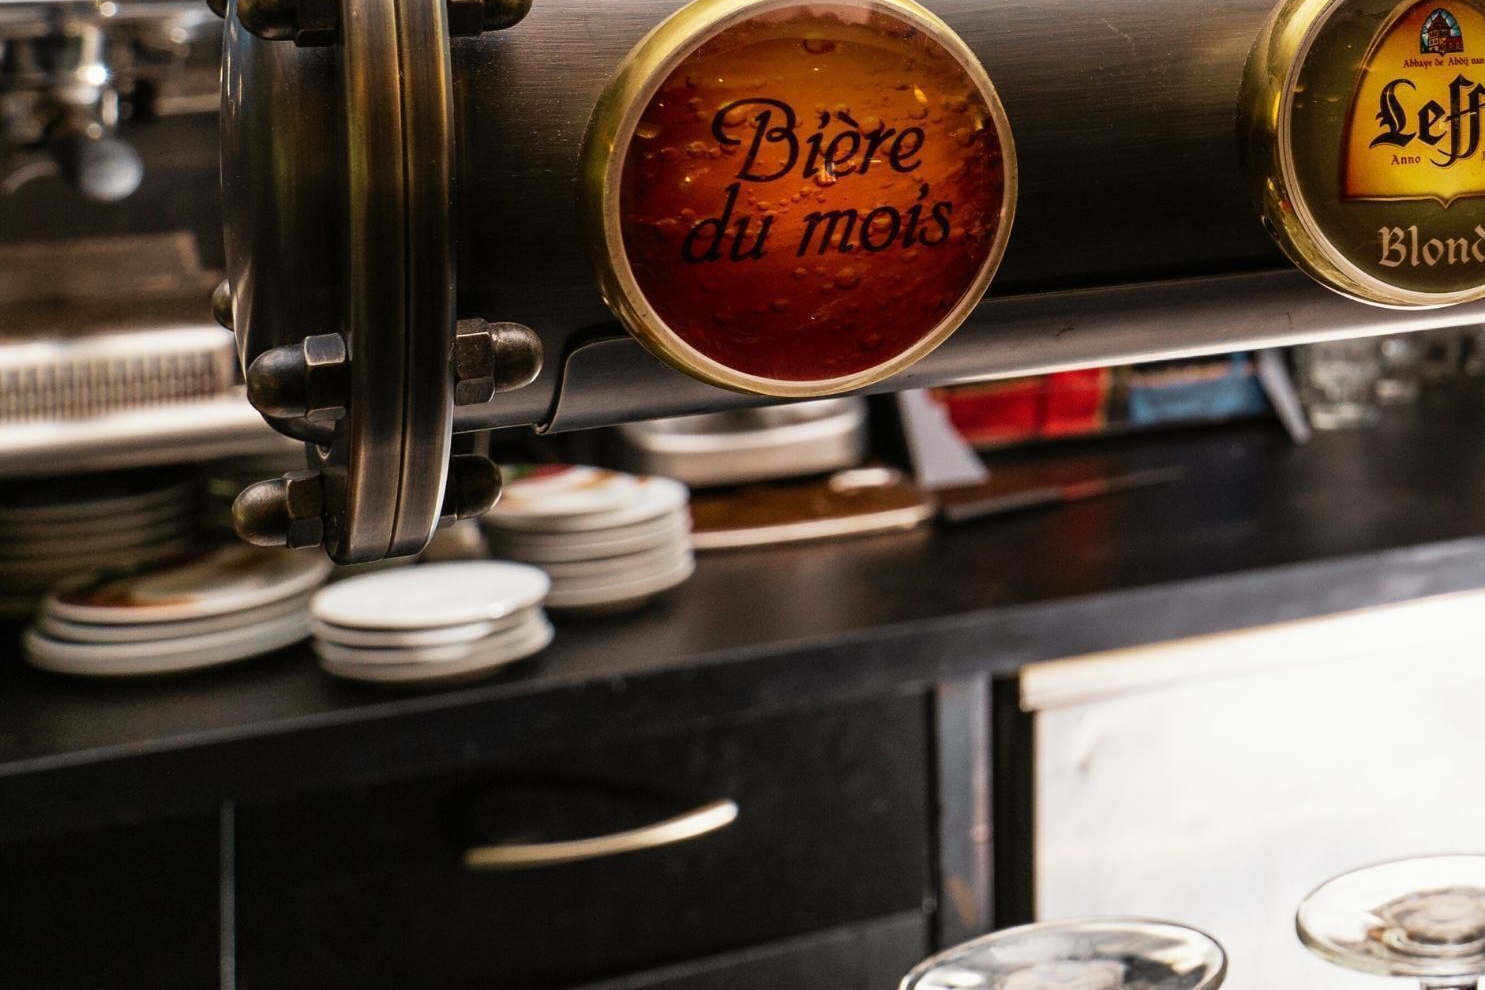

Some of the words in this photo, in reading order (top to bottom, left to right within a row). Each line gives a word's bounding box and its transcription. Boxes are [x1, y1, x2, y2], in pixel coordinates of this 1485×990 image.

[1403, 59, 1432, 70] Abbaye
[712, 97, 926, 182] Bière
[1390, 154, 1421, 165] Anno
[682, 183, 775, 264] du
[797, 183, 954, 258] mois
